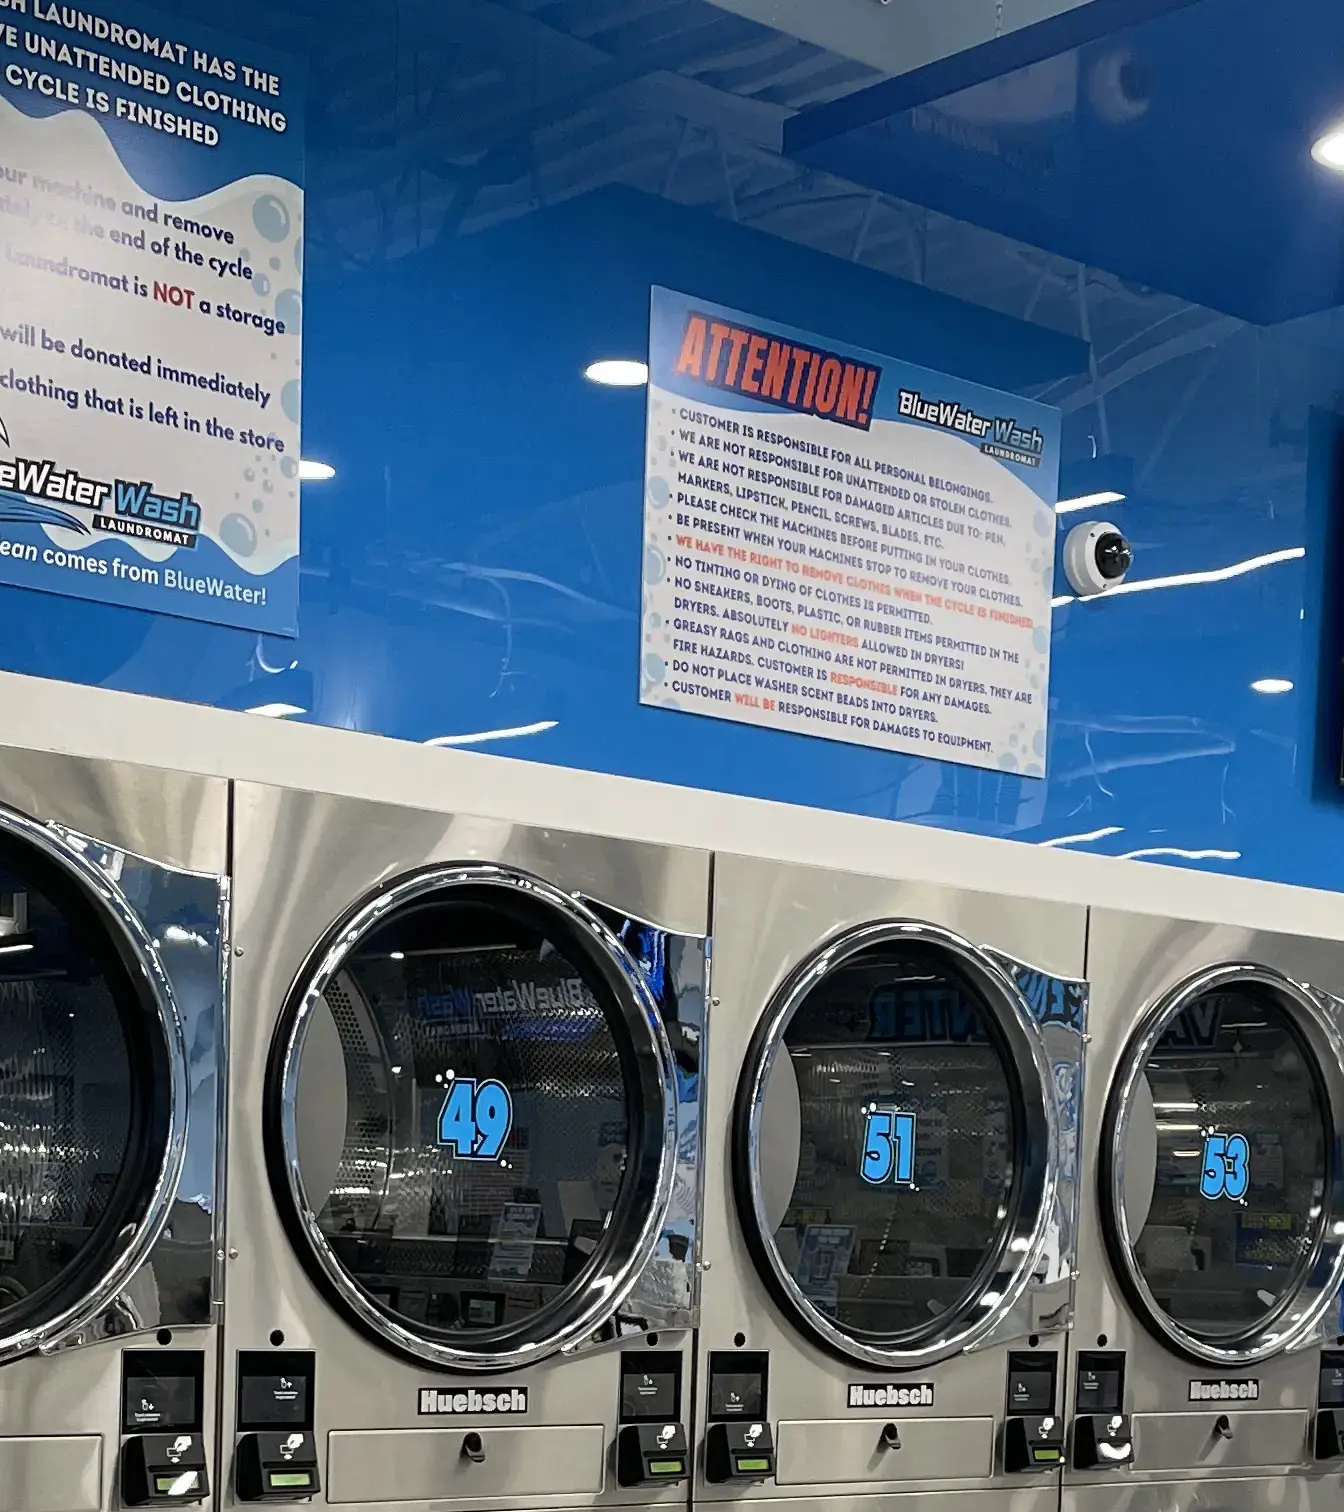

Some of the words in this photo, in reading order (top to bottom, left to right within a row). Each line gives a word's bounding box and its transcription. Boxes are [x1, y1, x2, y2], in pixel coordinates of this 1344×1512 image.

[33, 0, 187, 65] LAUNDROMAT
[193, 49, 236, 81] HAS
[241, 65, 279, 96] THE
[5, 64, 79, 104] CYCLE
[85, 87, 109, 112] IS
[115, 97, 218, 146] FINISHED
[25, 31, 170, 94] UNATTENDED
[176, 81, 286, 132] CLOTHING
[121, 201, 158, 224] and
[163, 213, 234, 245] remove
[153, 280, 195, 309] NOT
[215, 302, 286, 336] storage
[675, 316, 878, 426] ATTENTION!
[83, 387, 124, 415] that
[129, 397, 144, 419] is
[148, 401, 179, 428] left
[183, 410, 200, 433] in
[205, 416, 234, 441] the
[238, 428, 285, 453] store
[897, 390, 992, 438] BlueWater
[992, 419, 1044, 454] Wash
[679, 407, 740, 435] CUSTOMER
[742, 424, 754, 438] IS
[756, 428, 829, 459] RESPONSIBLE
[830, 448, 851, 465] FOR
[853, 455, 872, 471] ALL
[873, 460, 926, 486] PERSONAL
[928, 475, 993, 503] BELONGINGS.
[99, 516, 190, 546] LAUNDROMAT
[116, 483, 200, 528] Wash
[42, 543, 108, 575] comes
[111, 557, 158, 585] from
[164, 568, 266, 605] BlueWater!
[671, 679, 731, 702] CUSTOMER
[762, 697, 775, 711] BE
[777, 700, 848, 725] RESPONSIBLE
[850, 715, 870, 729] FOR
[872, 719, 920, 739] DAMAGES
[922, 729, 935, 742] TO
[937, 731, 994, 753] EQUIPMENT.
[437, 1079, 513, 1160] 49
[861, 1112, 915, 1182] 51
[1199, 1134, 1249, 1199] 53
[420, 1388, 527, 1414] Huebsch
[849, 1383, 934, 1408] Huebsch
[1190, 1380, 1258, 1401] Huebsch
